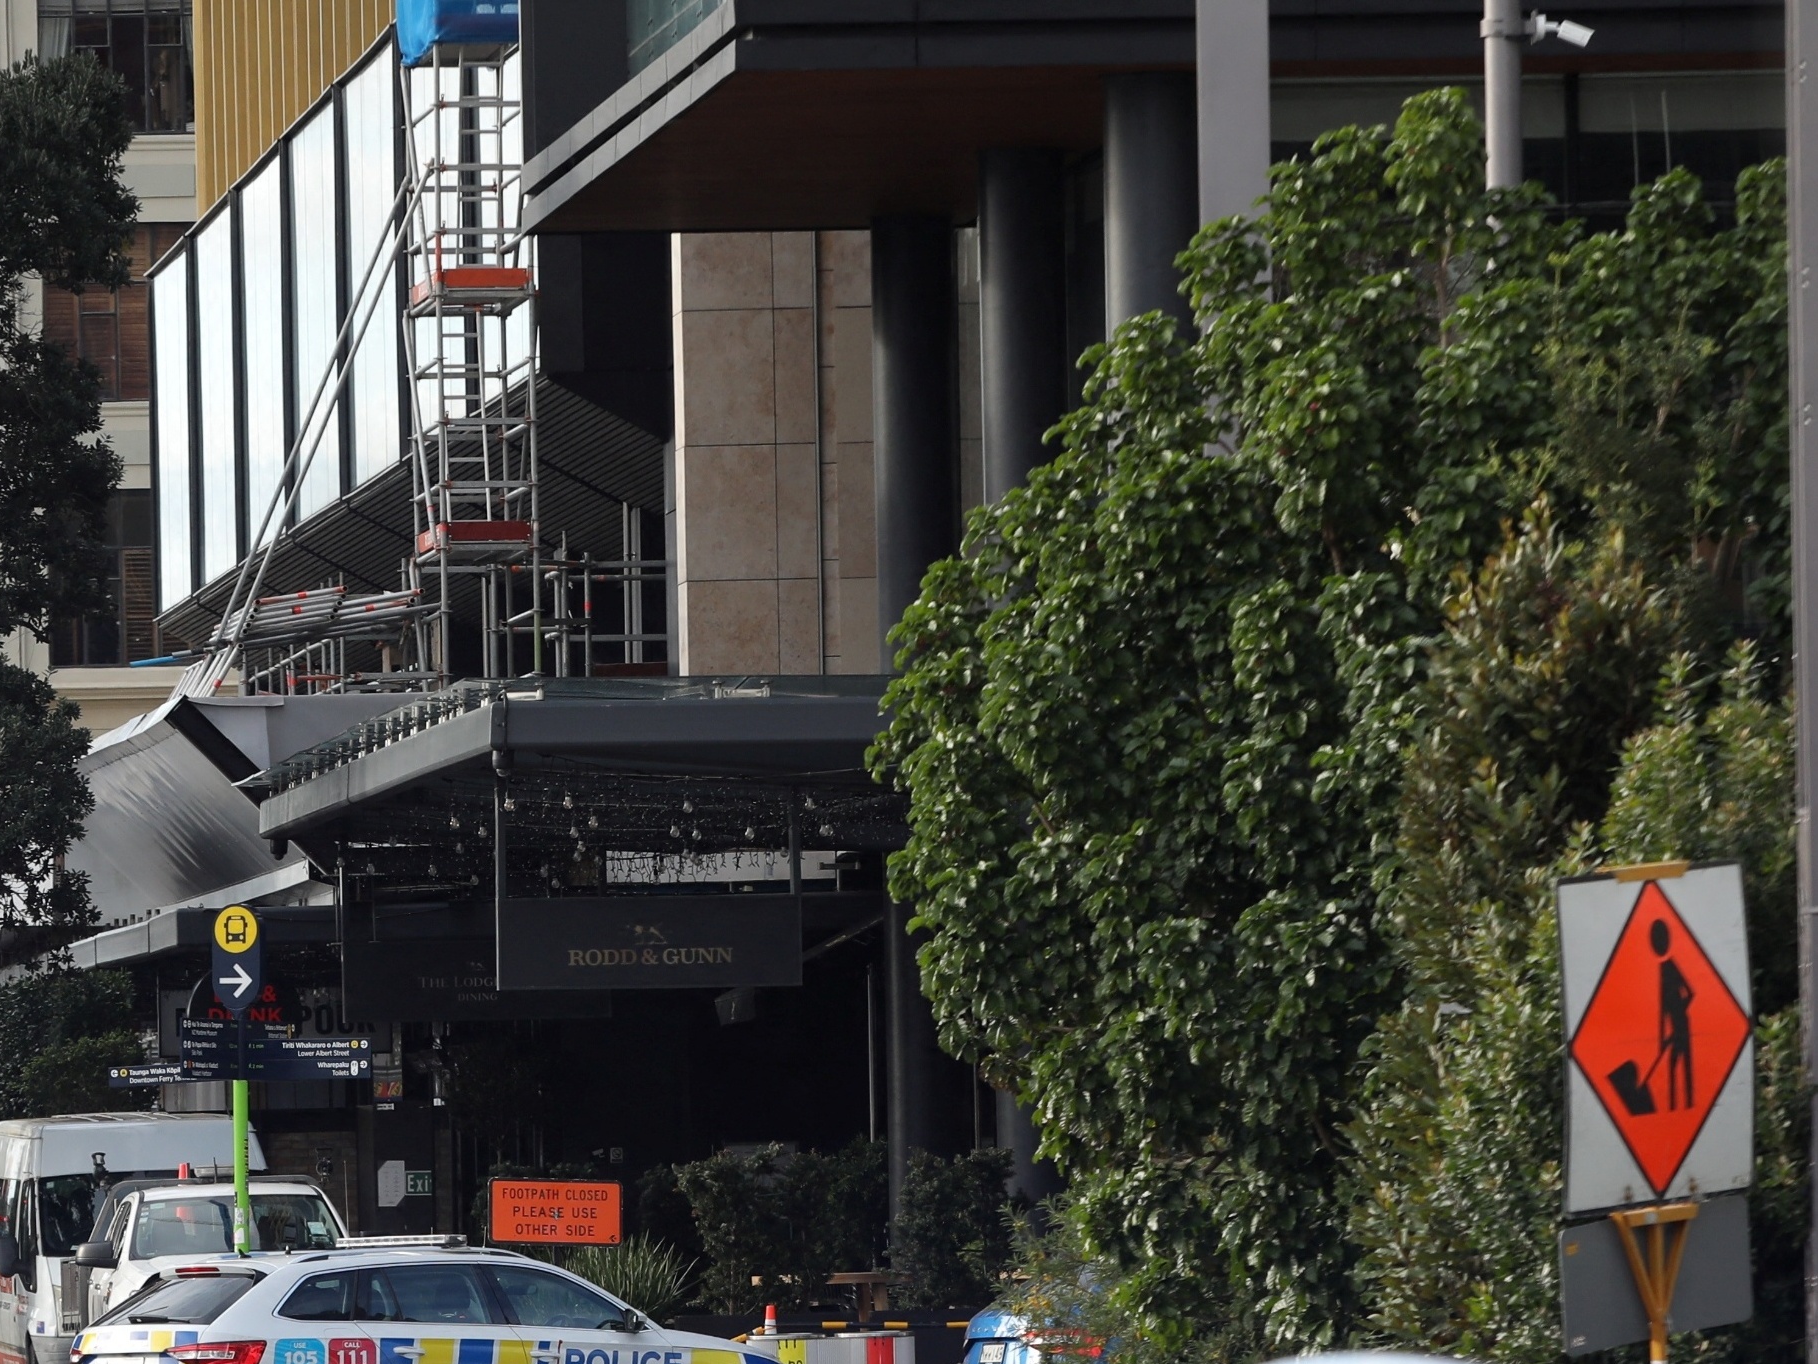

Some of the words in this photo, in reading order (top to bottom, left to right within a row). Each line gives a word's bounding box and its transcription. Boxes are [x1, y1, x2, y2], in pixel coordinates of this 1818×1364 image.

[568, 949, 637, 966] RODD
[641, 949, 659, 965] &
[663, 947, 733, 965] GUNN
[454, 975, 497, 988] LODG
[458, 992, 498, 1002] DINING
[208, 1007, 283, 1021] DNK
[332, 1041, 349, 1049] Albert
[317, 1061, 349, 1070] Wharepaku
[129, 1069, 149, 1077] Taunga
[129, 1076, 158, 1084] Downtown
[159, 1075, 173, 1083] Ferry
[407, 1174, 431, 1192] Exi
[502, 1187, 559, 1200] FOOTPATH
[566, 1189, 608, 1201] CLOSED
[513, 1206, 564, 1218] PLEASE
[572, 1208, 597, 1219] USE
[515, 1224, 557, 1236] OTHER
[566, 1225, 595, 1236] SIDE
[337, 1350, 368, 1364] 111
